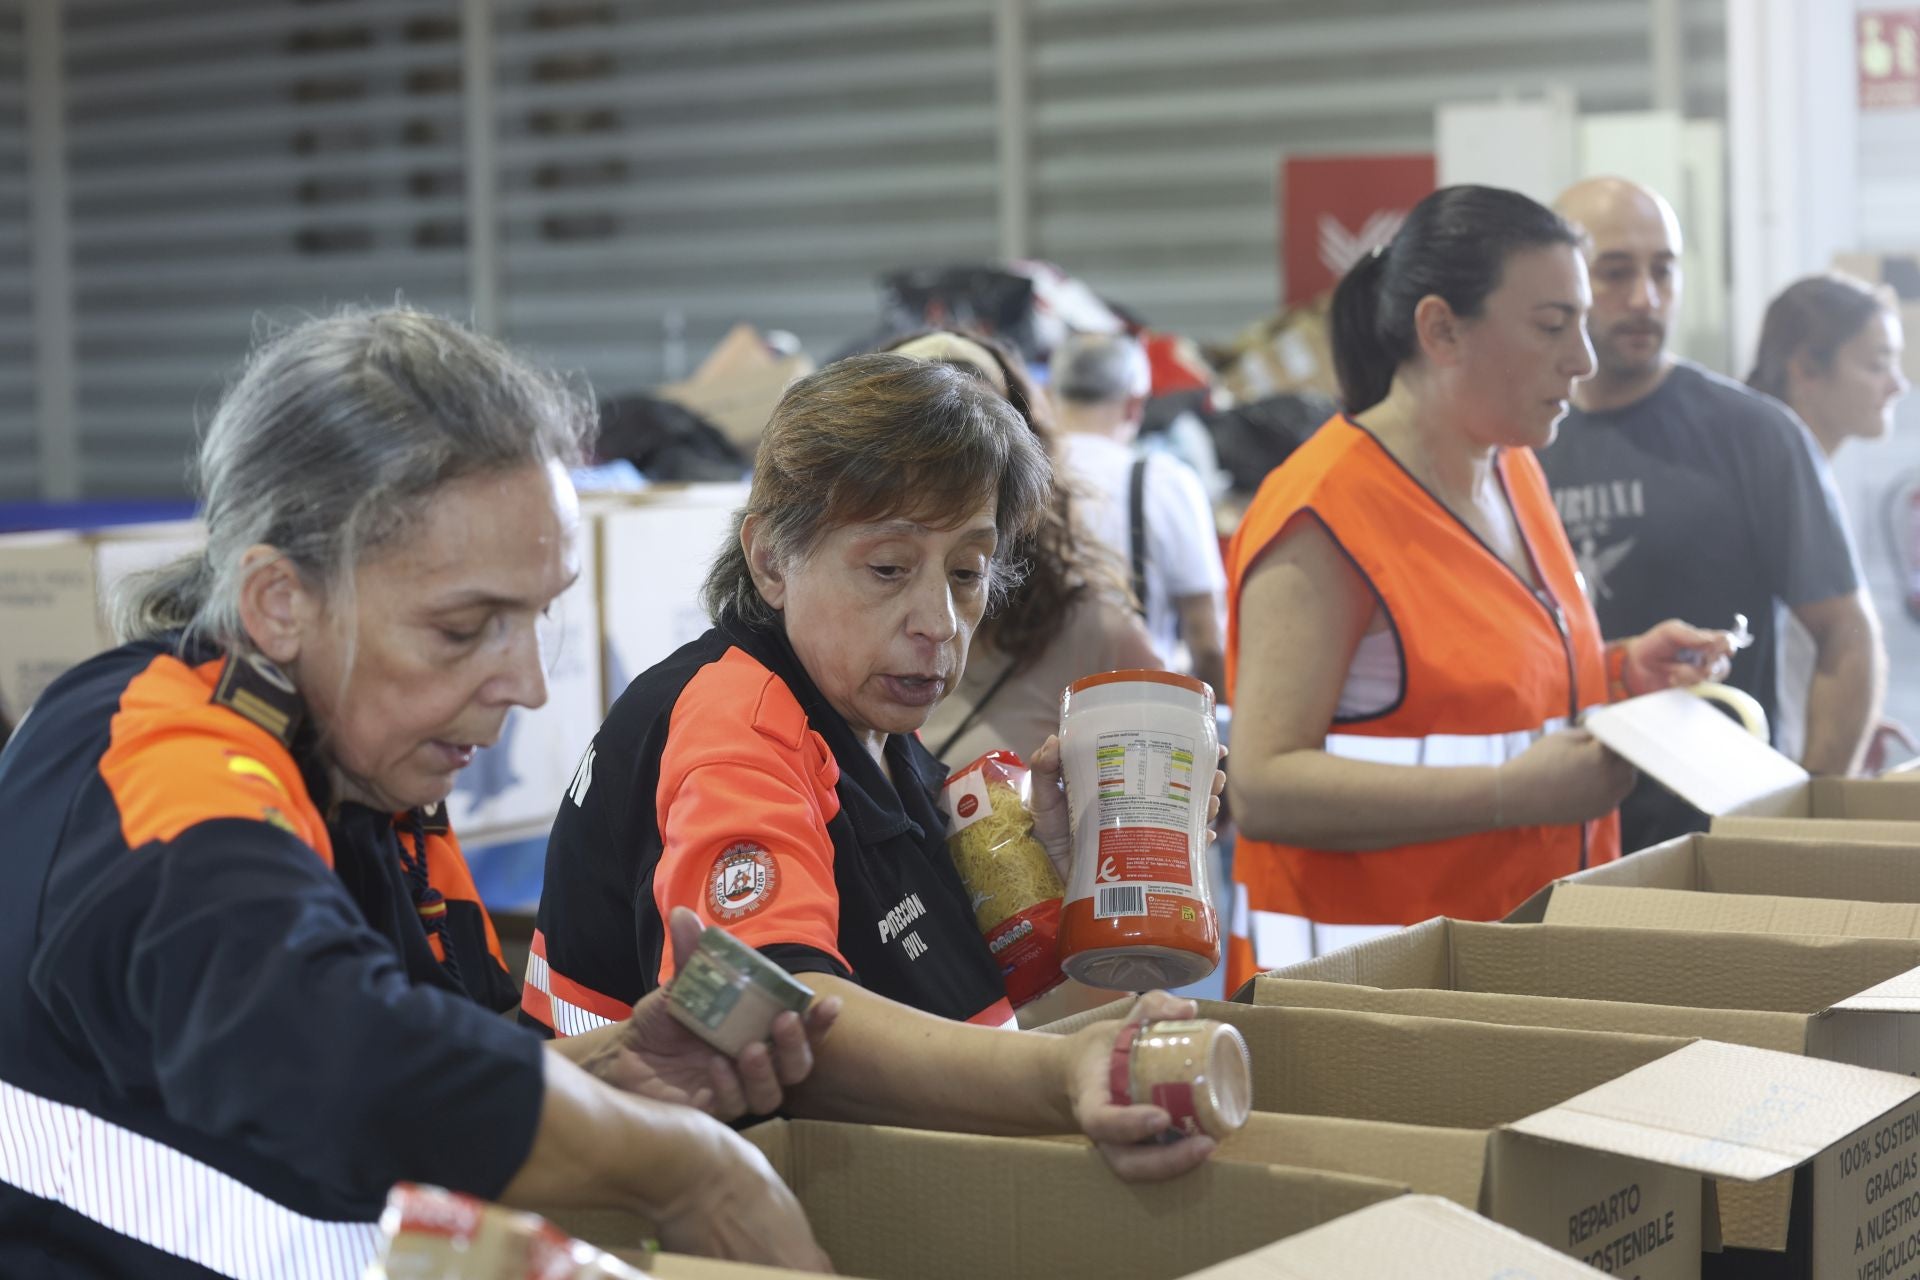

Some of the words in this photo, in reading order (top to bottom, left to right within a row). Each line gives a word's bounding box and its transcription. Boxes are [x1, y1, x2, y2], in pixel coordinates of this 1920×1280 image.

[878, 892, 927, 944] PTECCIÓN
[1839, 1137, 1871, 1180] 100%
[1866, 1151, 1918, 1205] GRACIAS
[1568, 1183, 1640, 1248] REPARTO
[1854, 1226, 1864, 1255] A
